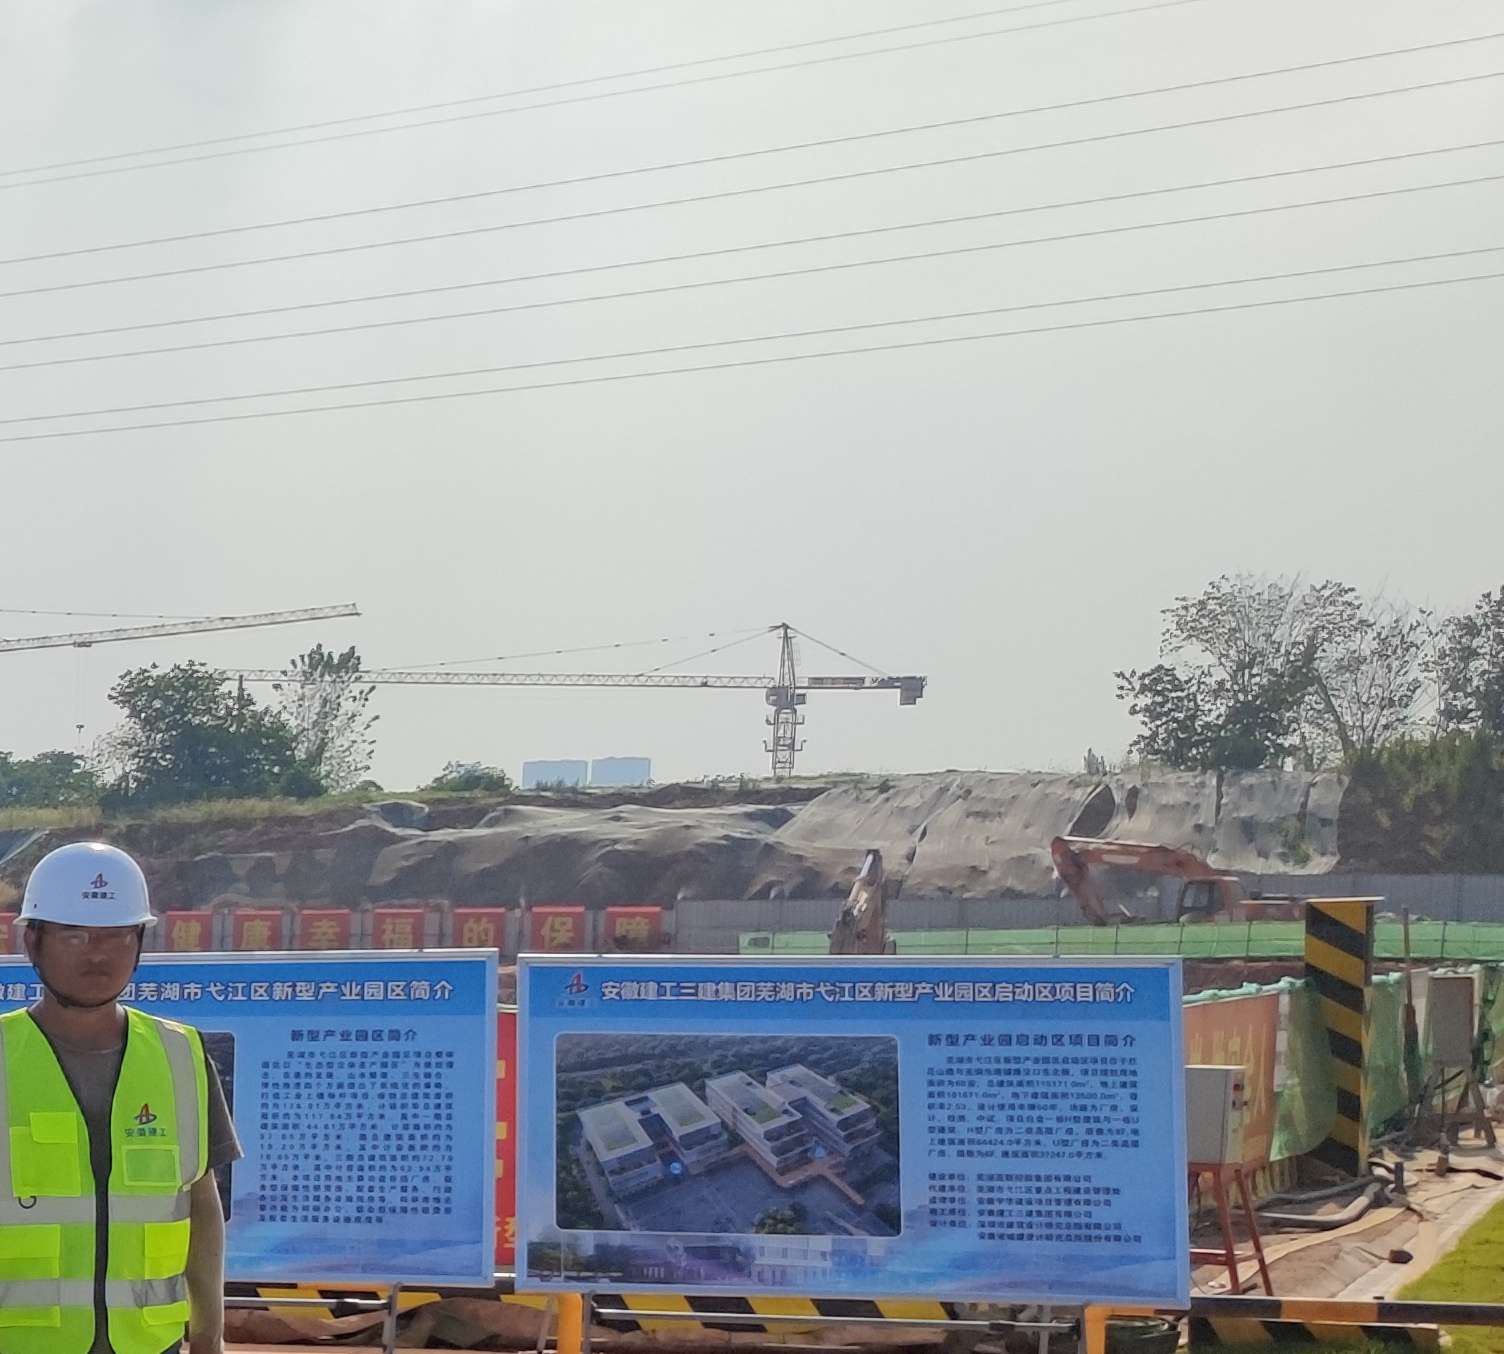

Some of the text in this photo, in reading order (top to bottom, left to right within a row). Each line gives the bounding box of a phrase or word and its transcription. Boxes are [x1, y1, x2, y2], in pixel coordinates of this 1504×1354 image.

[600, 979, 1135, 1005] 安徽建工三建集团芜湖市弋江区新型产业园区启动区项目简介
[291, 1029, 417, 1042] 新型产业园区简介
[927, 1034, 1137, 1047] 新型产业园启动区项目简介
